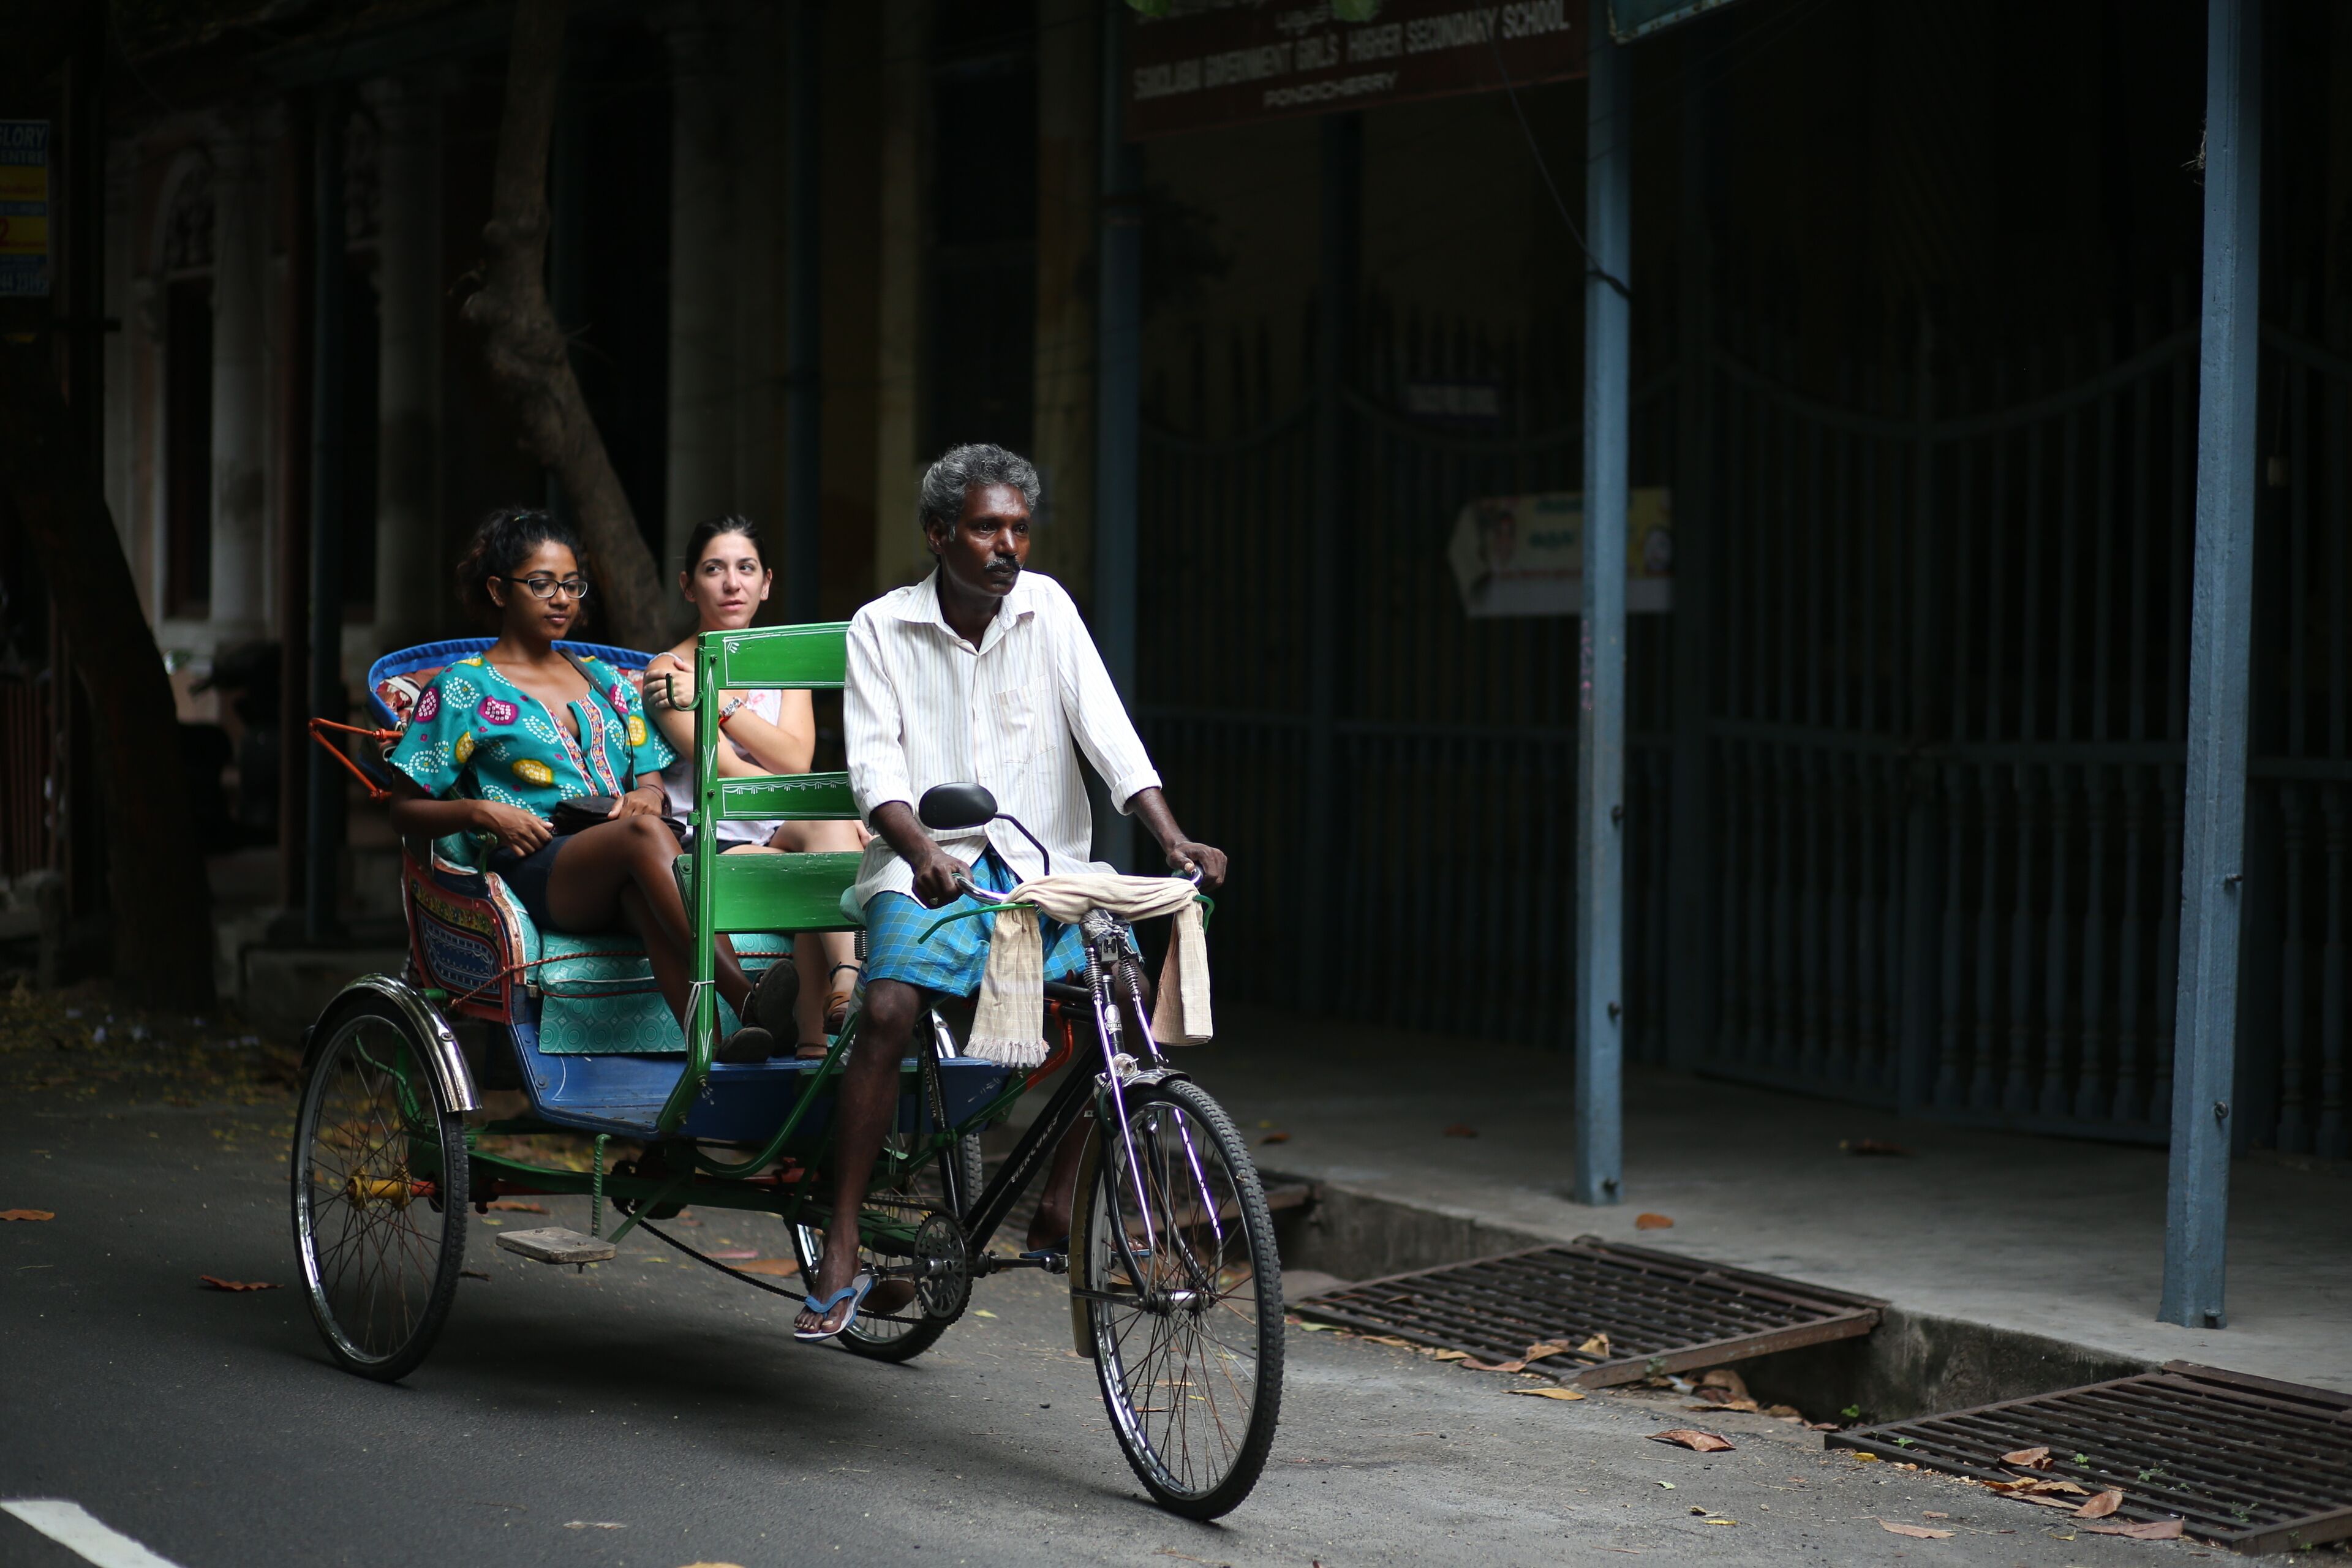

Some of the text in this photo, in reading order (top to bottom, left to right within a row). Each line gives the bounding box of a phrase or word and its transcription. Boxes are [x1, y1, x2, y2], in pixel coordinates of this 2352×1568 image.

[1406, 6, 1500, 55] SECONDARY
[1502, 0, 1572, 40] SCHOOL
[1263, 70, 1400, 109] PONDICHERRY
[0, 125, 46, 148] LORY
